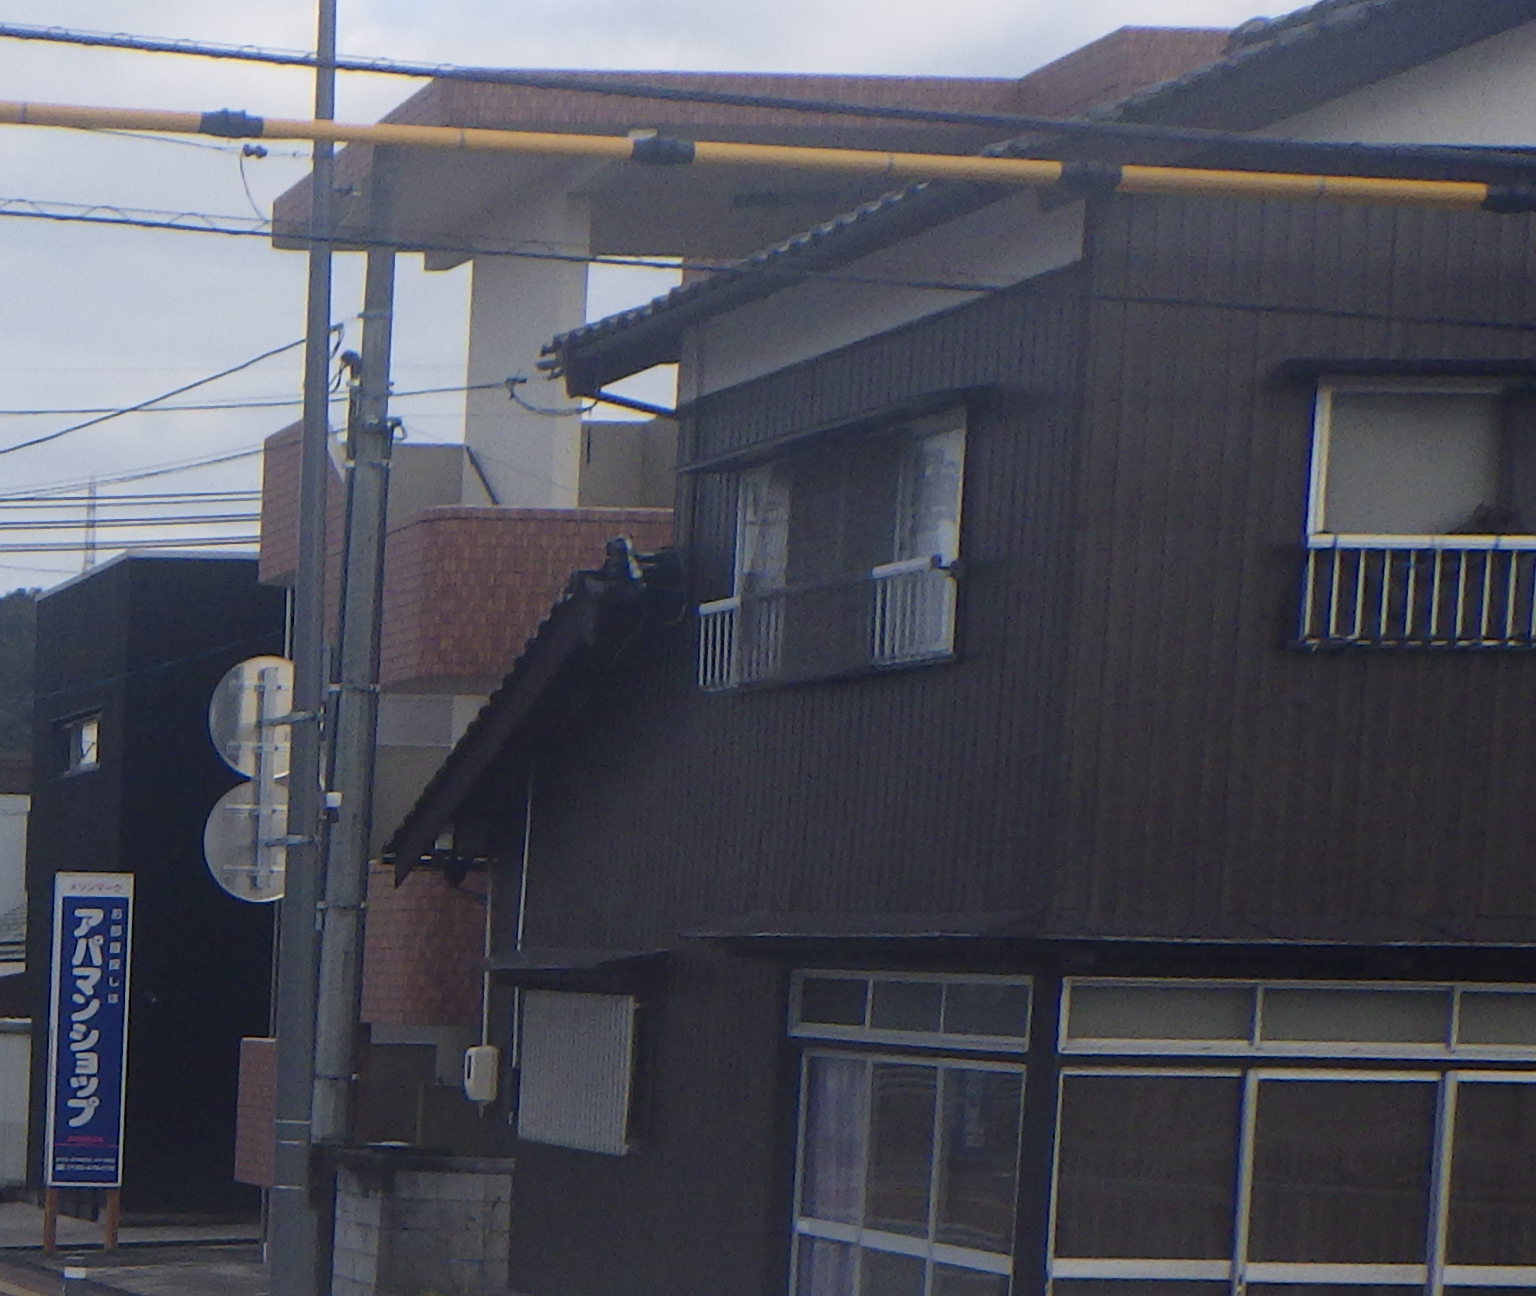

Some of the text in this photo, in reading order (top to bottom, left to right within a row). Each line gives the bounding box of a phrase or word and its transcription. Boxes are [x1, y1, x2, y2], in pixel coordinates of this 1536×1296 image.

[67, 908, 105, 1128] アパマンショップ
